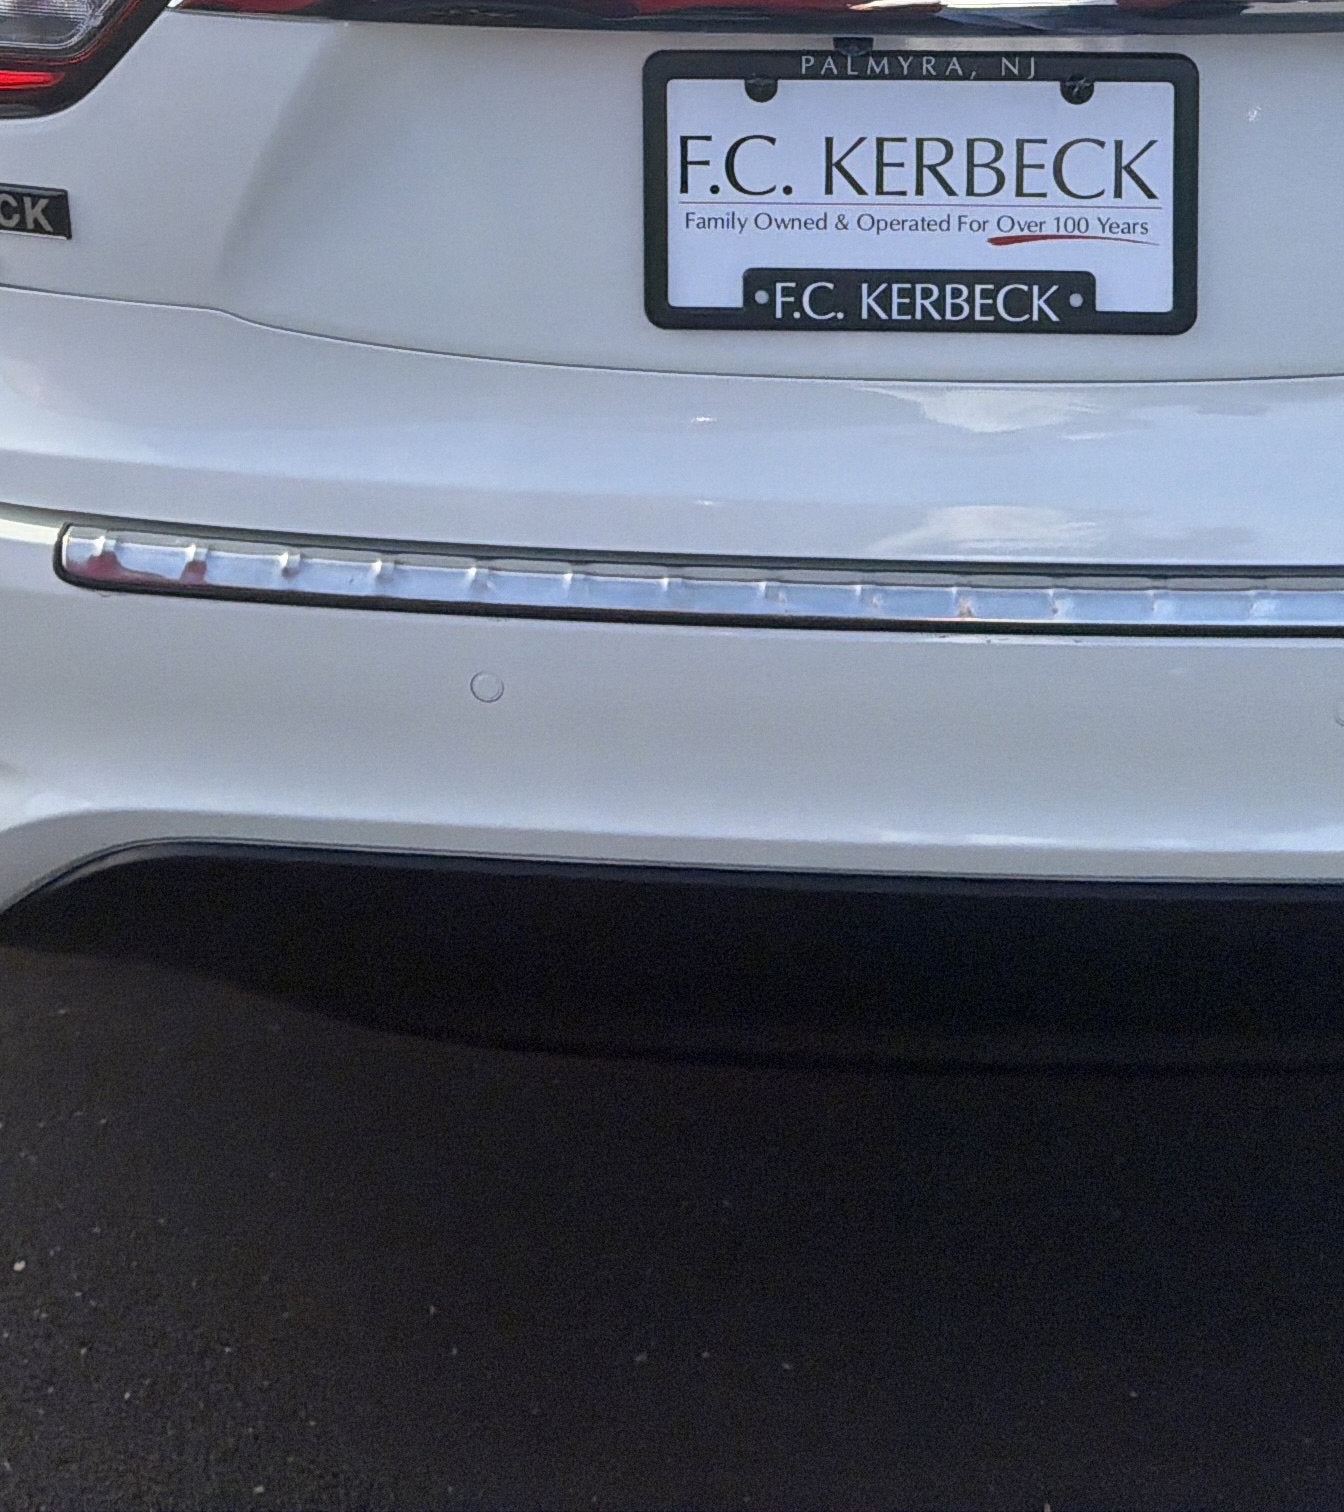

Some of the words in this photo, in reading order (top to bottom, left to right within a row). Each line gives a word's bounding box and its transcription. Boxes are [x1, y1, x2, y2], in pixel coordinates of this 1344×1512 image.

[800, 55, 977, 80] PALMYRA,
[1001, 56, 1037, 80] NJ
[679, 134, 793, 196] F.C.
[824, 136, 1160, 200] KERBECK
[685, 211, 748, 233] Family
[754, 211, 827, 231] Owned
[834, 213, 850, 231] &
[857, 213, 951, 235] Operated
[957, 214, 989, 233] For
[996, 215, 1047, 233] Over
[1055, 216, 1090, 234] 100
[1097, 217, 1150, 236] Years
[773, 282, 844, 322] F.C.
[860, 284, 1060, 324] KERBECK
